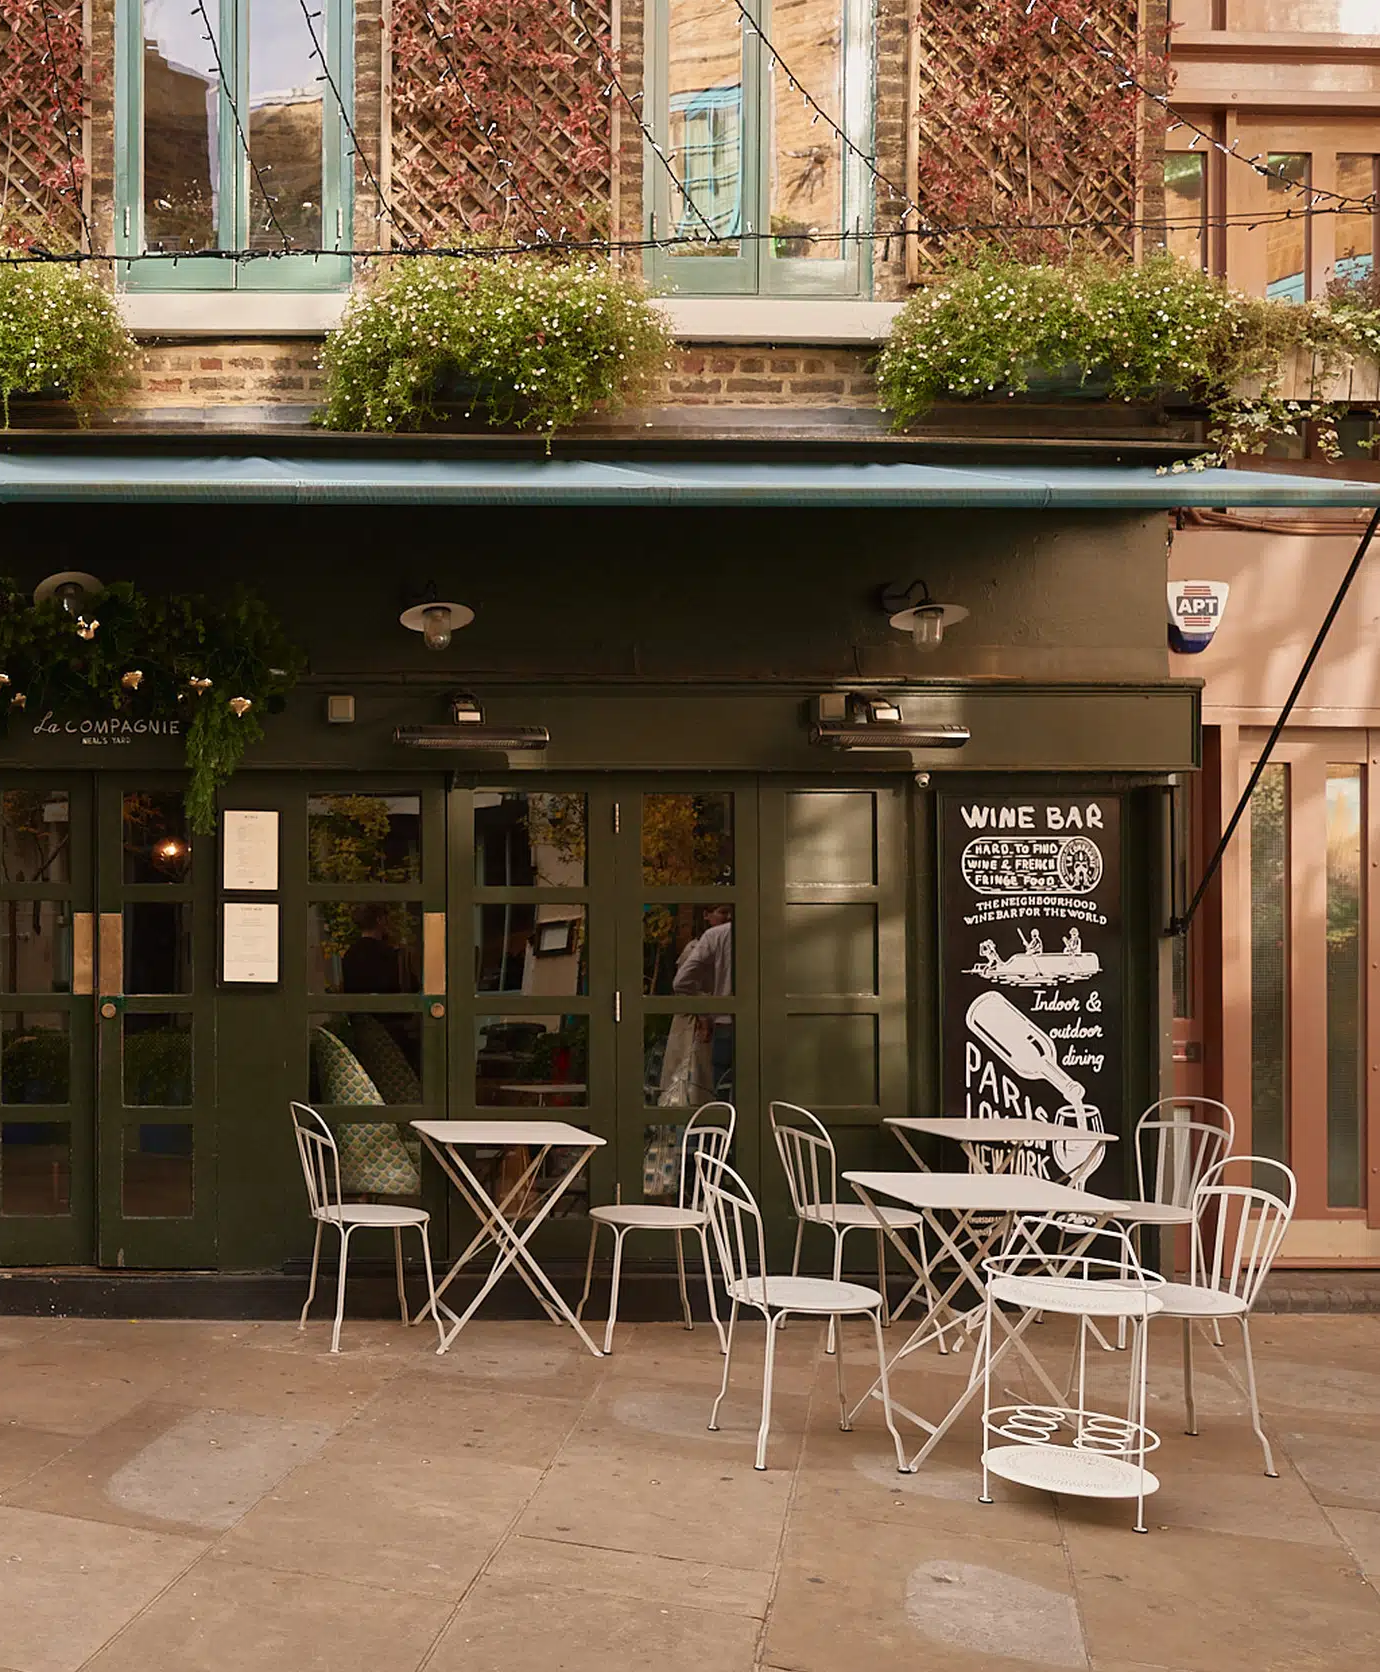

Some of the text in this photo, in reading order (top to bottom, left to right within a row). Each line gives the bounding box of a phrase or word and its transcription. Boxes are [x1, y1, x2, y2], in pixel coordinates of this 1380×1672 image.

[1177, 598, 1217, 614] APT
[33, 711, 180, 735] La COMPAGNIE
[960, 803, 1104, 830] WINE BAR
[975, 844, 1009, 855] HARD
[1033, 844, 1059, 854] FIND
[967, 859, 1055, 871] WINE & FRENCH
[975, 875, 1018, 886] FRINGE
[976, 897, 1097, 912] THE NEIGHBOURHOOD
[963, 907, 1108, 925] WINE BAR FOR THE WORLD
[1030, 990, 1102, 1012] Indoor &
[1049, 1017, 1104, 1039] outdoor
[1061, 1044, 1105, 1073] dining
